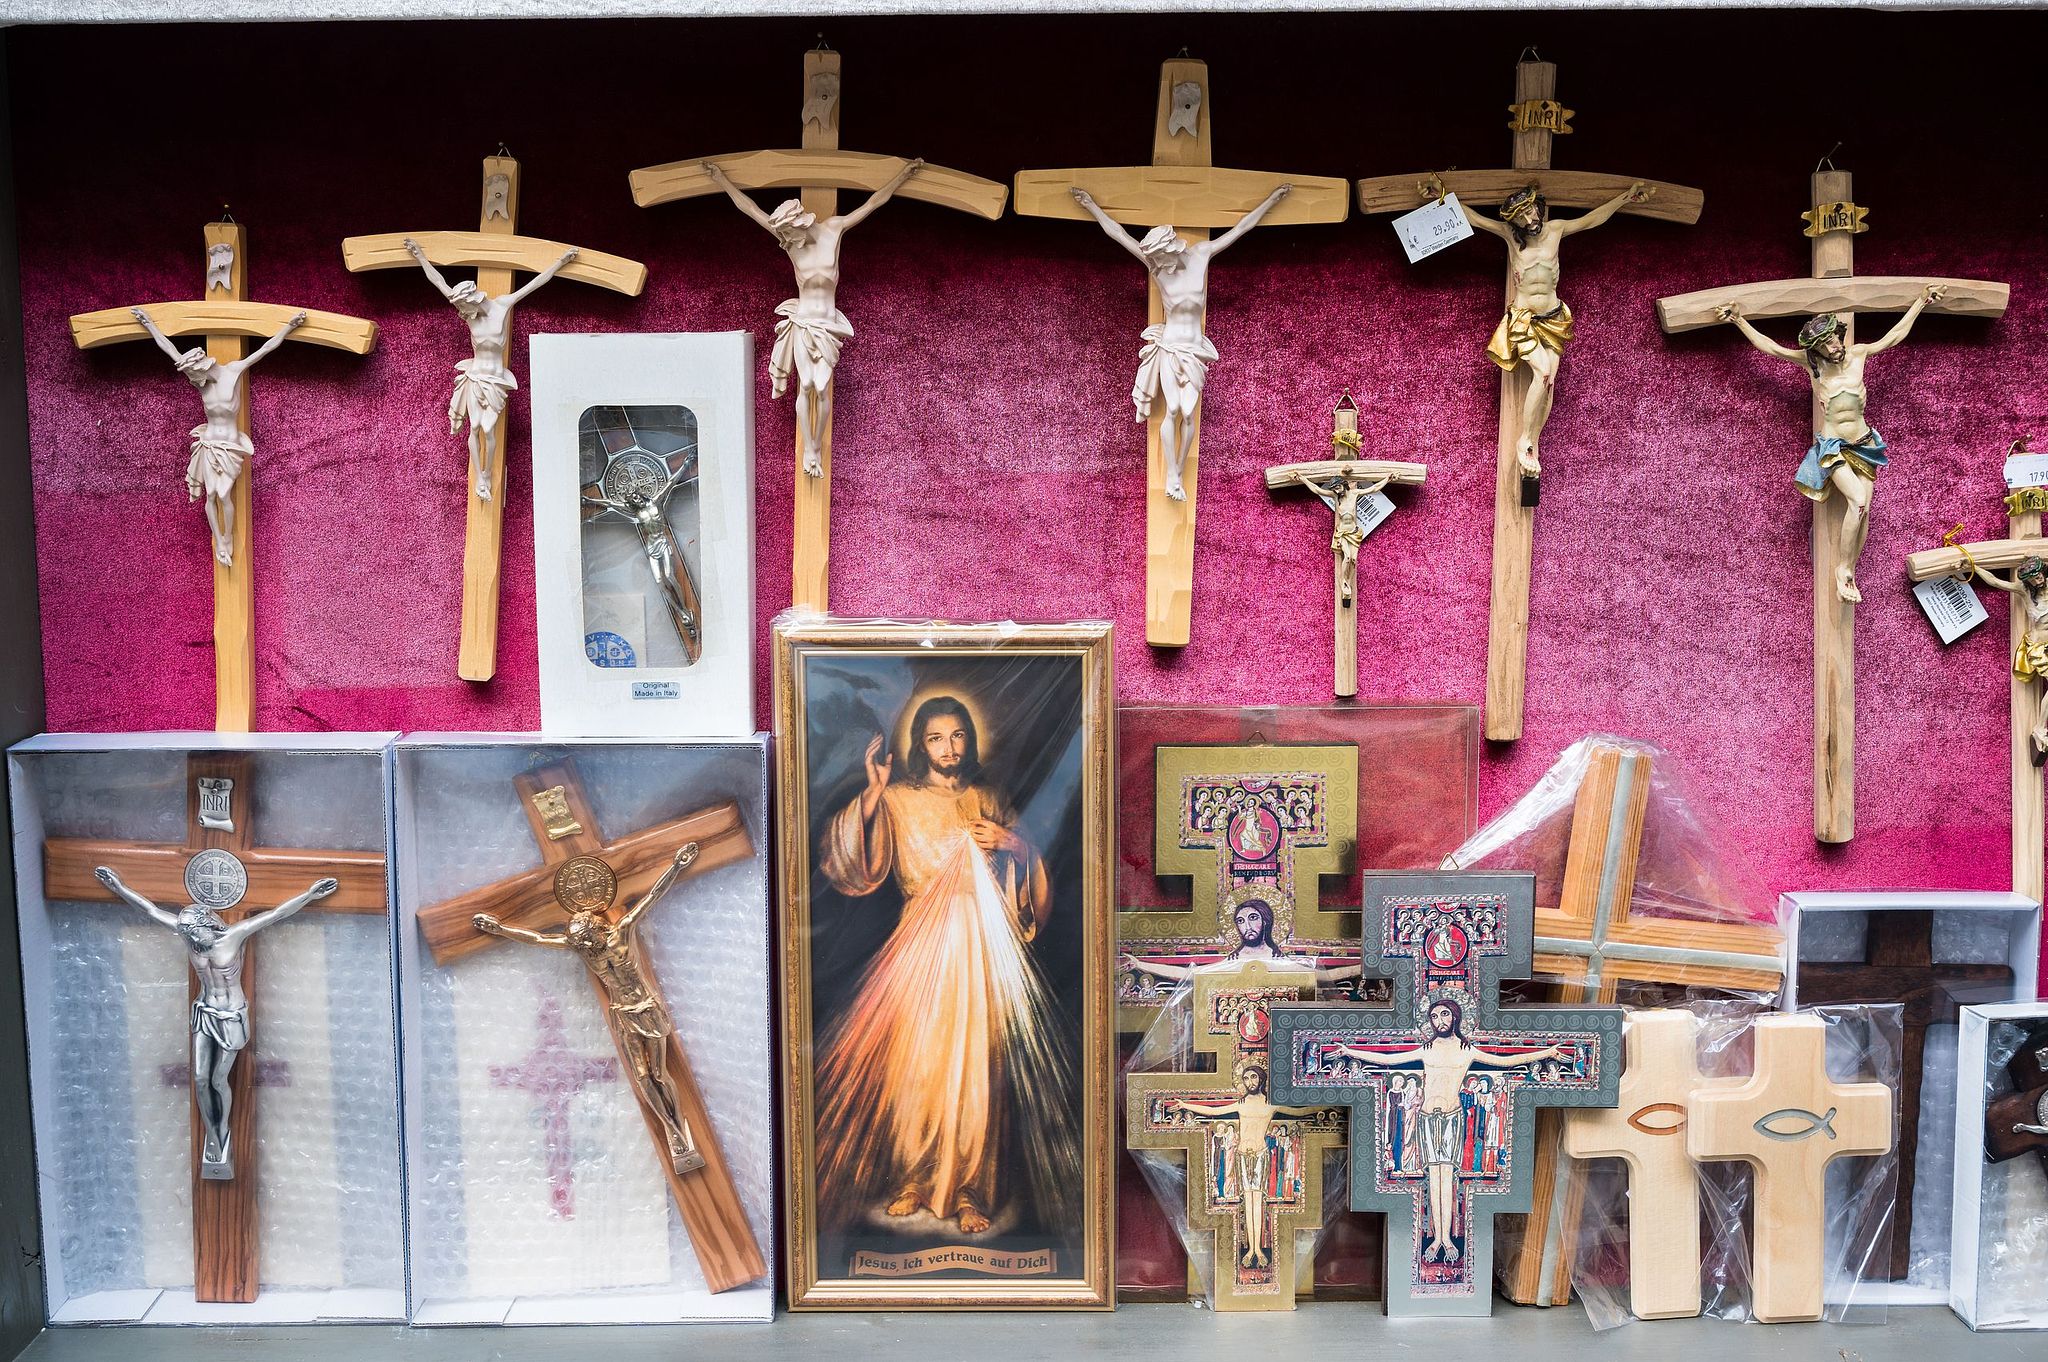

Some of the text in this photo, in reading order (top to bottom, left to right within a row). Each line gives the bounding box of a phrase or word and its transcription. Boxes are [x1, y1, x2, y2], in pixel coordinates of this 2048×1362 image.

[1527, 109, 1559, 126] INRI
[1432, 218, 1456, 236] 29.90
[1822, 212, 1854, 229] INRI
[642, 682, 670, 690] Original
[663, 689, 679, 698] Italy
[202, 794, 229, 812] INRI
[858, 1251, 1048, 1273] Jesus, ich vertraue auf Dich
